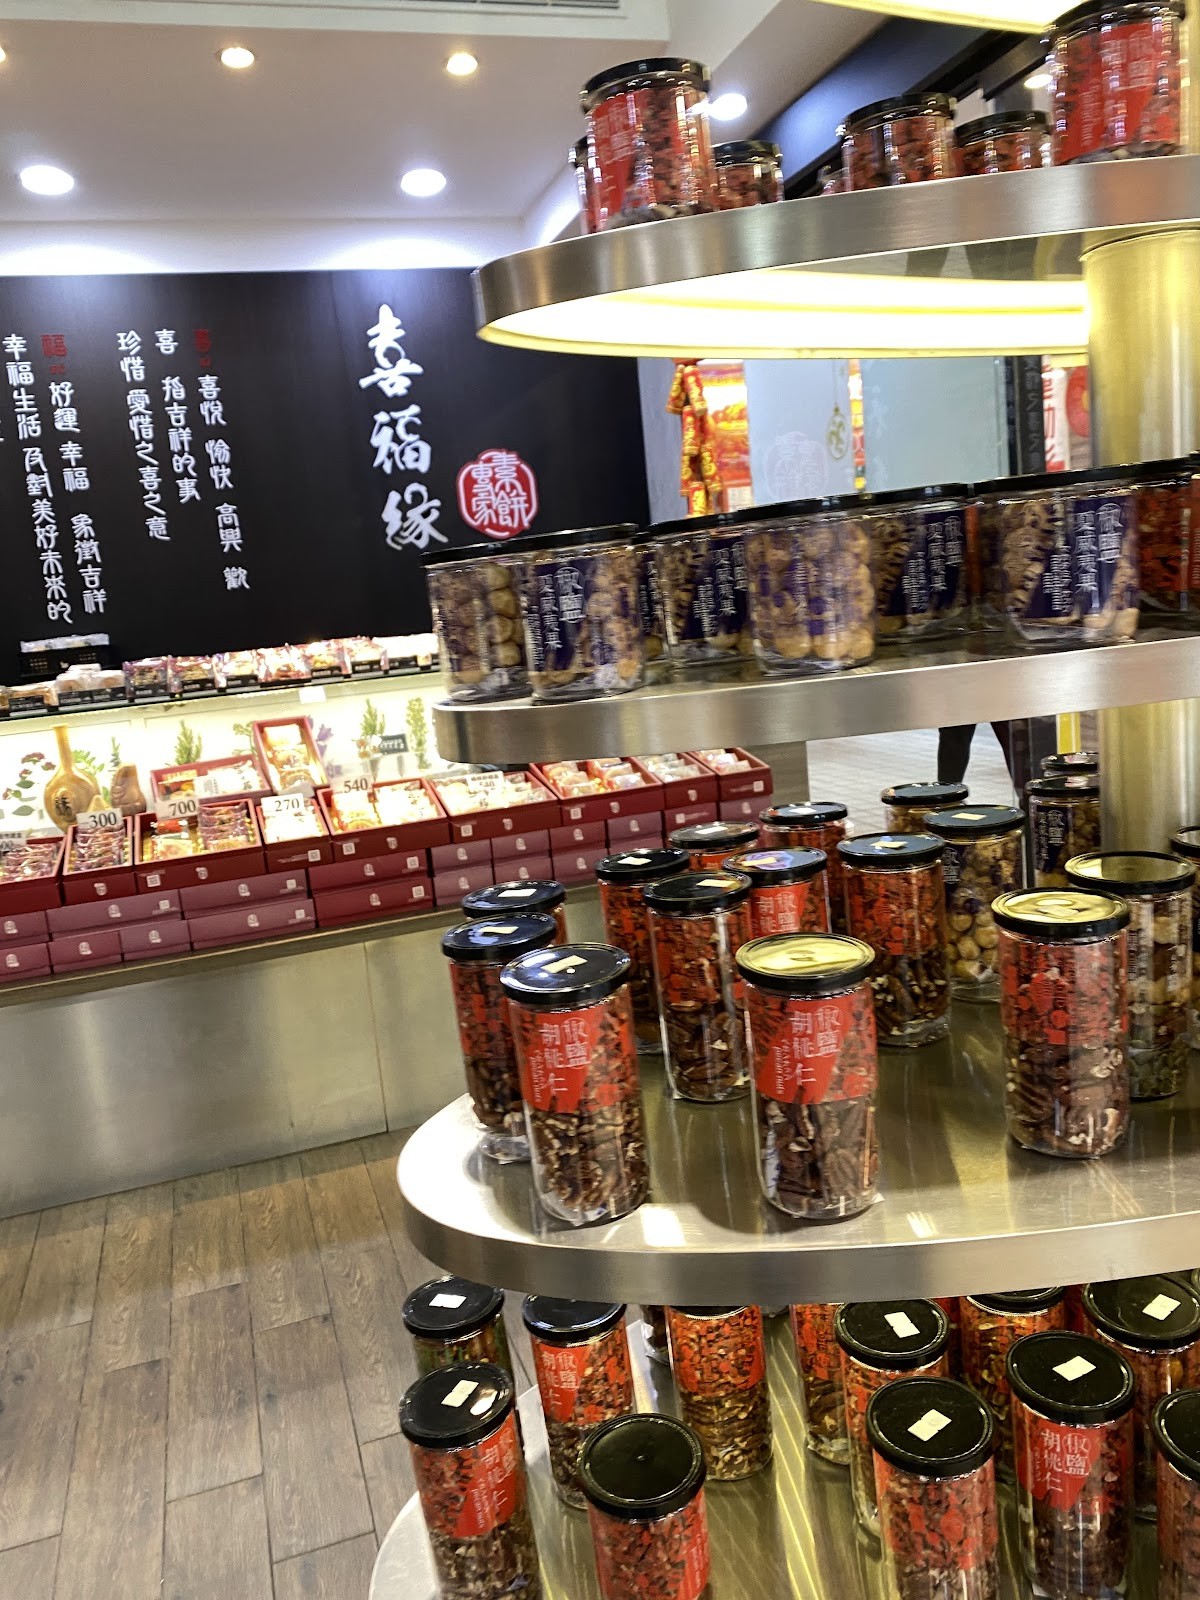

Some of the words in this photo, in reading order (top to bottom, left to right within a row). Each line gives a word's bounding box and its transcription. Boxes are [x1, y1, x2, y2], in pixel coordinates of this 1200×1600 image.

[155, 328, 178, 355] 喜
[49, 381, 81, 433] 好運
[198, 374, 227, 426] 喜悅
[359, 303, 449, 550] 喜福緣
[59, 441, 90, 492] 幸福
[205, 438, 234, 490] 愉快
[215, 502, 243, 552] 高興
[70, 513, 107, 614] 象徵吉祥
[169, 799, 197, 817] 700
[274, 797, 300, 812] 270
[343, 777, 368, 793] 540
[89, 811, 117, 829] 300
[538, 1022, 569, 1096] 胡桃仁
[787, 1010, 817, 1086] 胡桃仁
[1040, 1428, 1064, 1493] 胡桃仁
